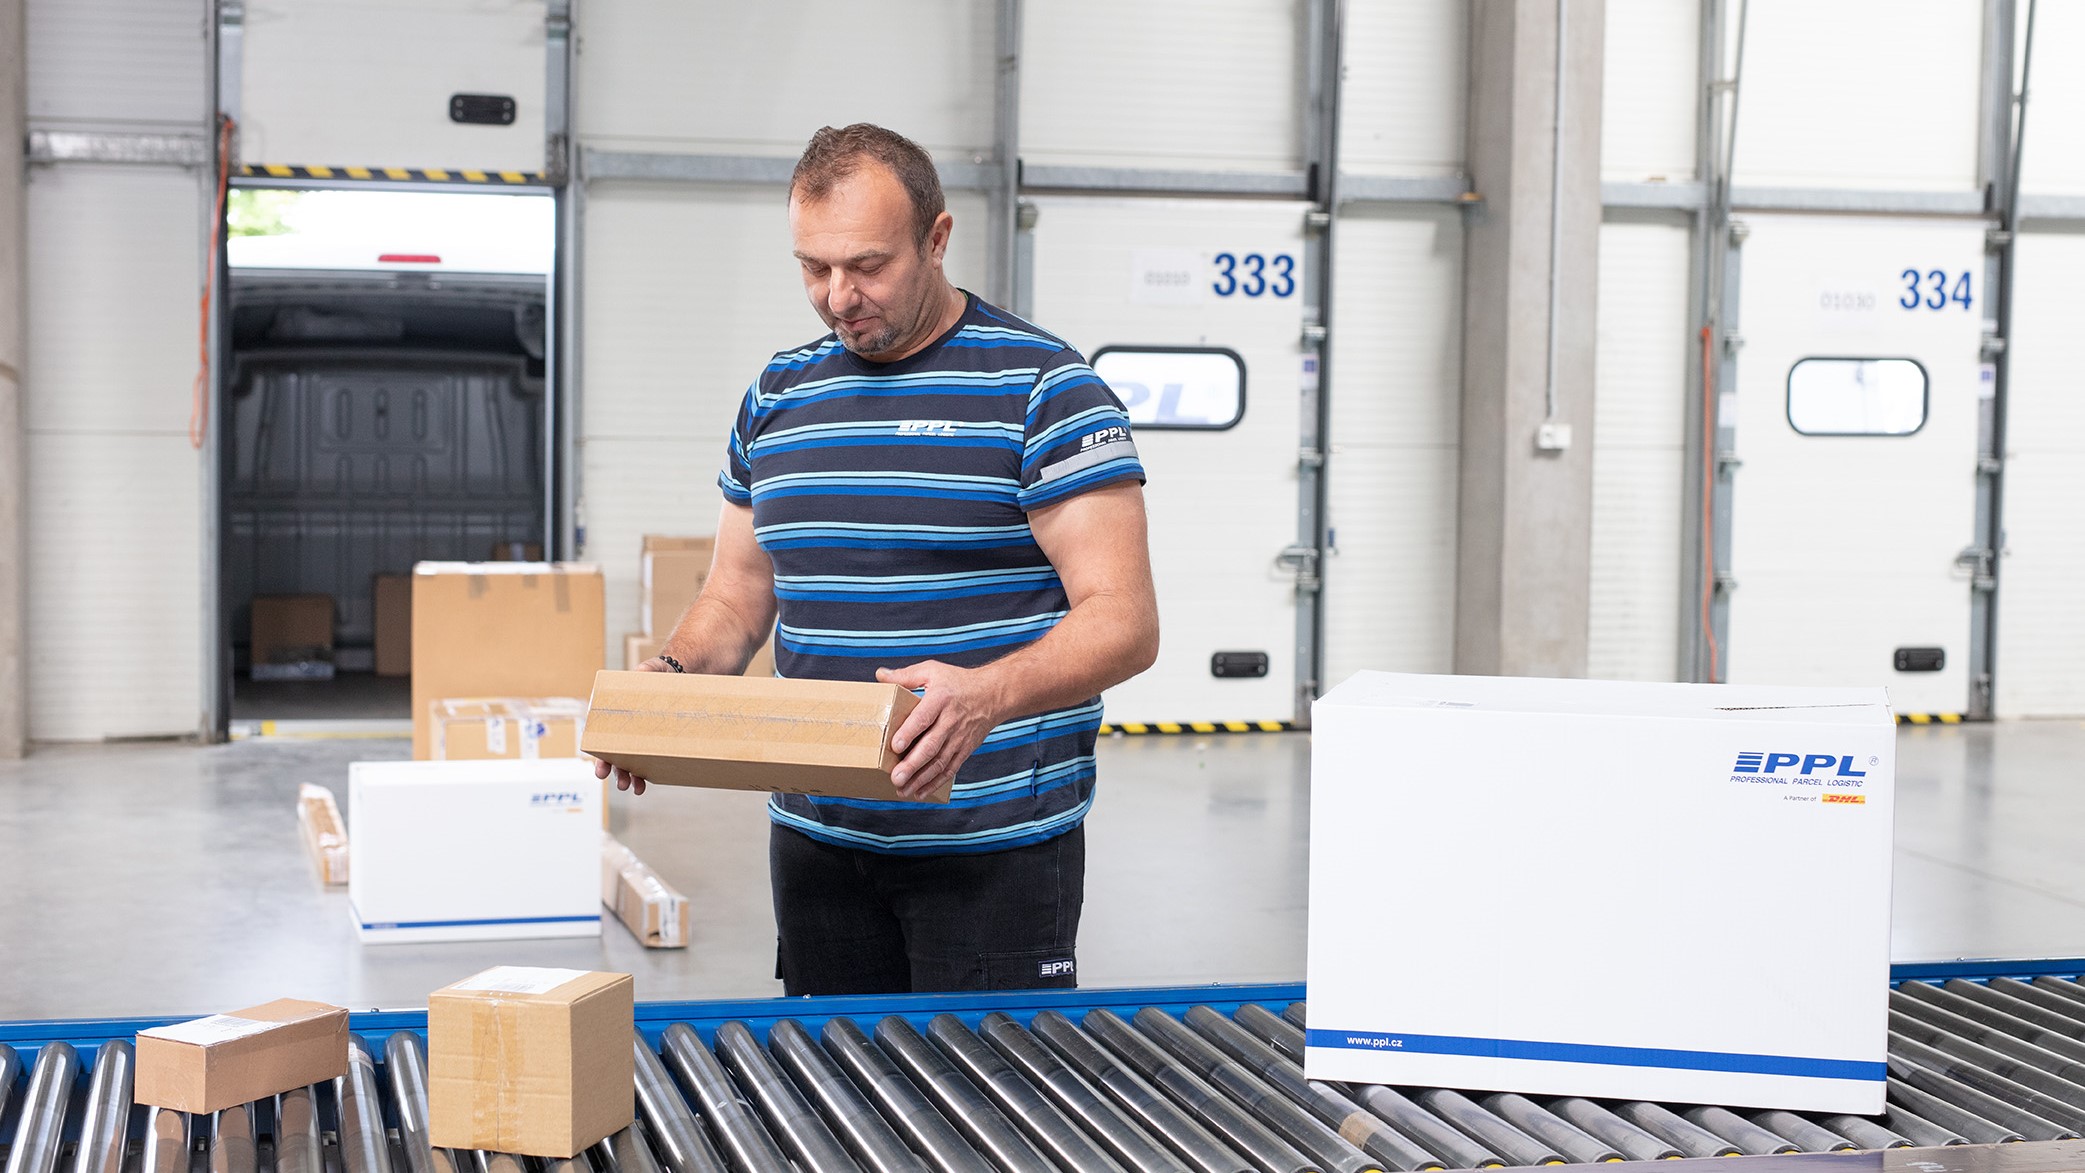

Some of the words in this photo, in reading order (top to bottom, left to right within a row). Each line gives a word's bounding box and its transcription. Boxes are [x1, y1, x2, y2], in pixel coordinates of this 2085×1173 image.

[1213, 253, 1295, 297] 333
[1900, 269, 1973, 310] 334
[910, 420, 958, 432] PPL
[1095, 426, 1127, 443] PPL
[1763, 753, 1867, 777] PPL
[1730, 775, 1789, 785] PROFESSIONAL
[1792, 777, 1823, 786] PARCEL
[1827, 779, 1864, 788] LOGISTIC
[1828, 795, 1860, 804] DHL
[1346, 1036, 1403, 1048] www.ppl.cz
